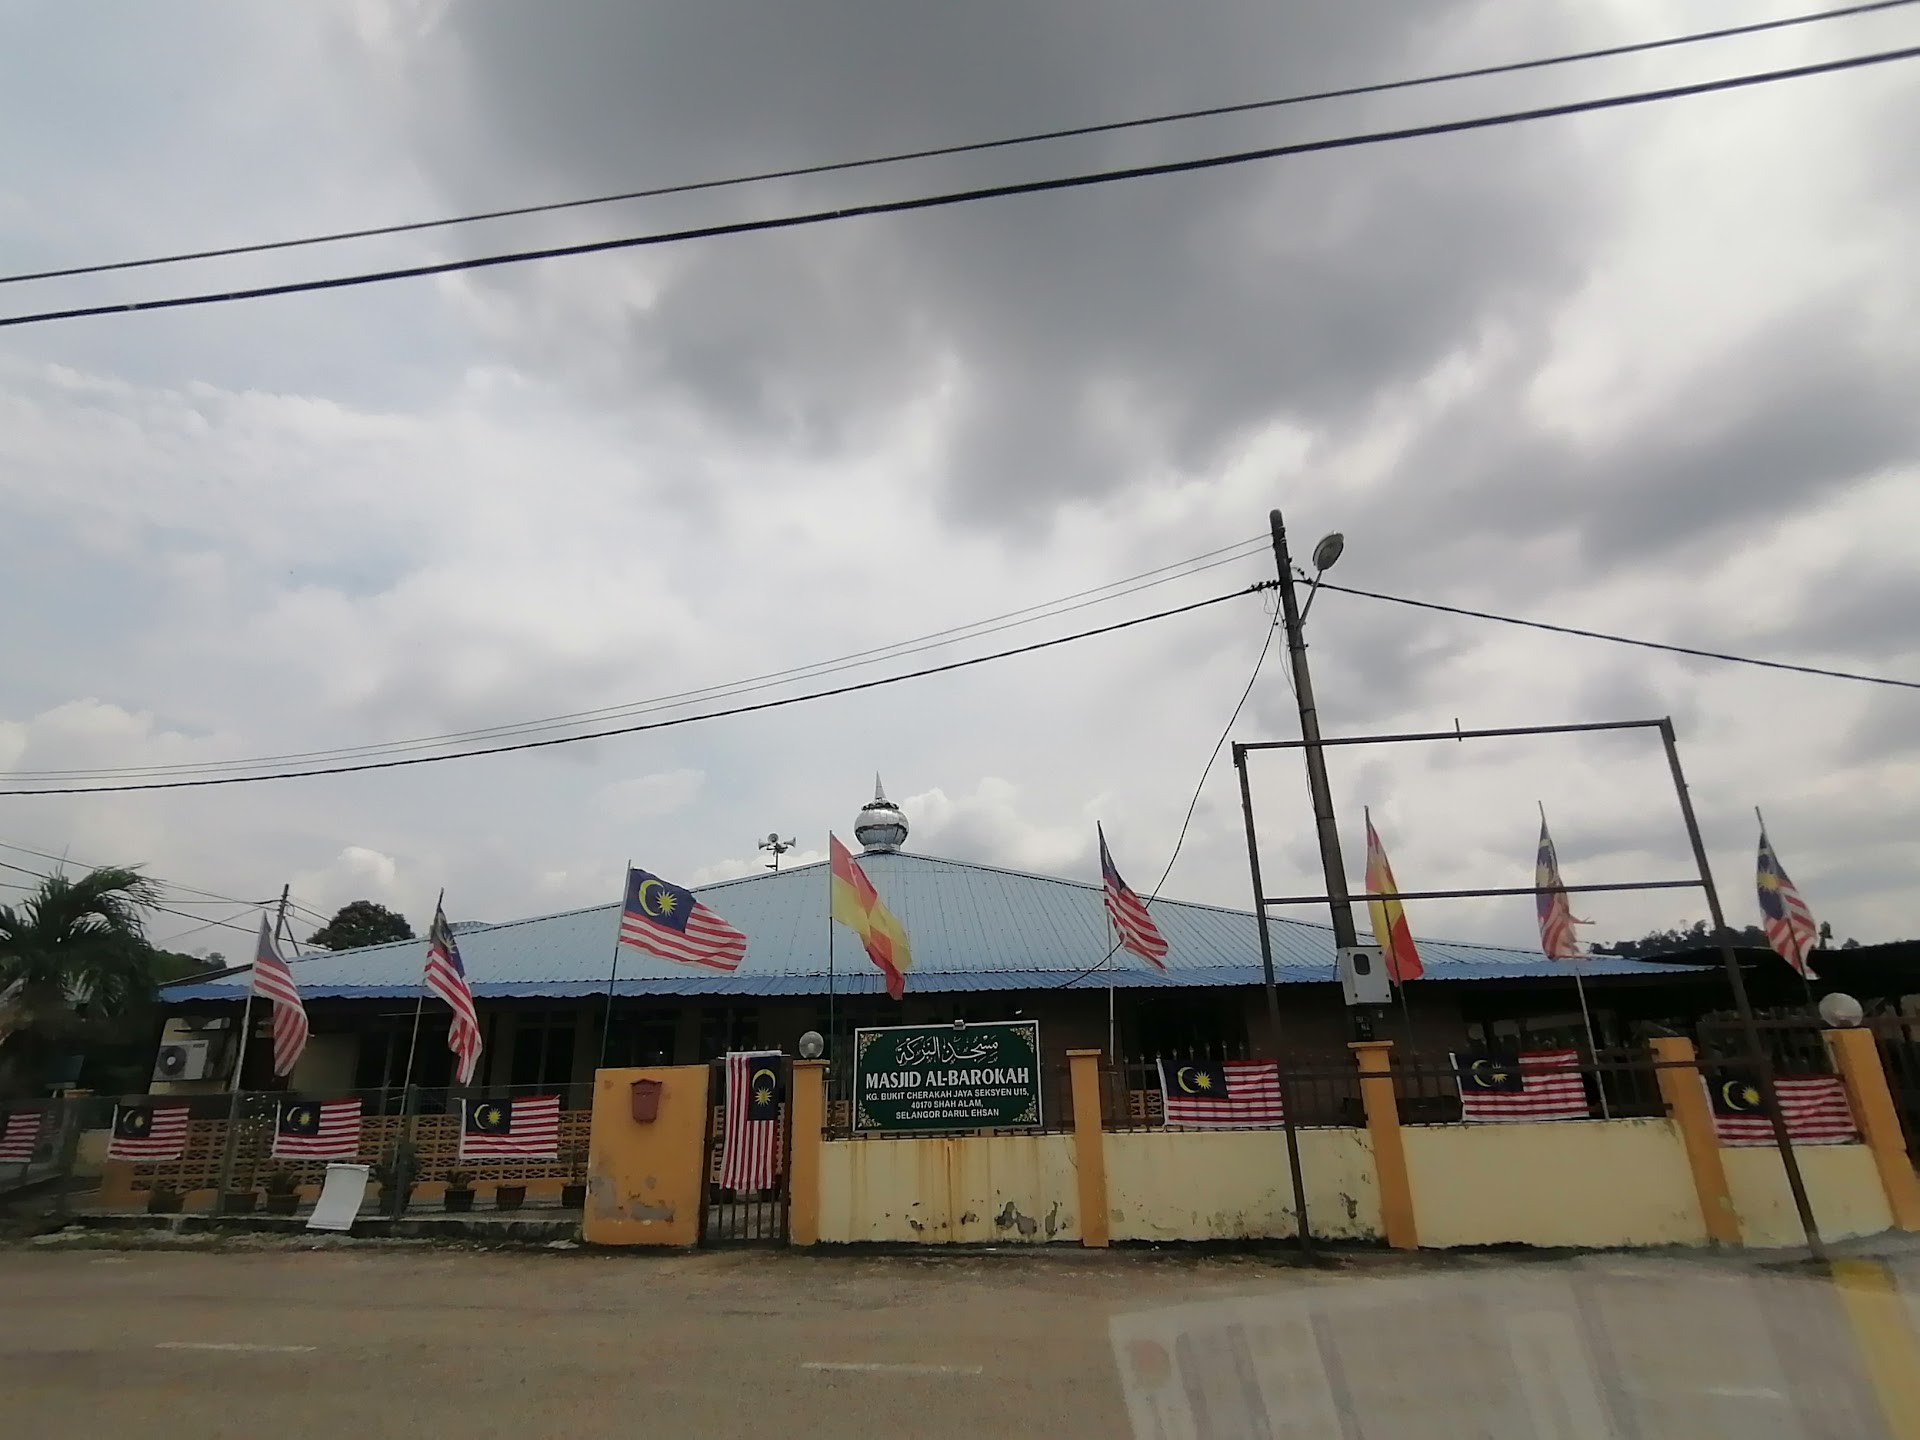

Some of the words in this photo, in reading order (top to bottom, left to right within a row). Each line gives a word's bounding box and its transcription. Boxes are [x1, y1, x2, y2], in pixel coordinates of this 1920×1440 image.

[865, 1071, 921, 1089] MASJID
[925, 1067, 1029, 1087] AL-BAROKAH
[866, 1093, 880, 1101] KG.
[881, 1092, 904, 1100] BUKIT
[906, 1090, 952, 1099] CHERAKAH
[953, 1089, 973, 1098] JAYA
[974, 1088, 1012, 1097] SEKSYEN
[1014, 1087, 1030, 1096] U15,
[911, 1101, 932, 1109] 40170
[934, 1100, 956, 1108] SHAH
[957, 1099, 983, 1108] ALAM,
[895, 1110, 940, 1120] SELANGOR
[942, 1109, 970, 1119] DARUL
[971, 1108, 999, 1117] EHSAN
